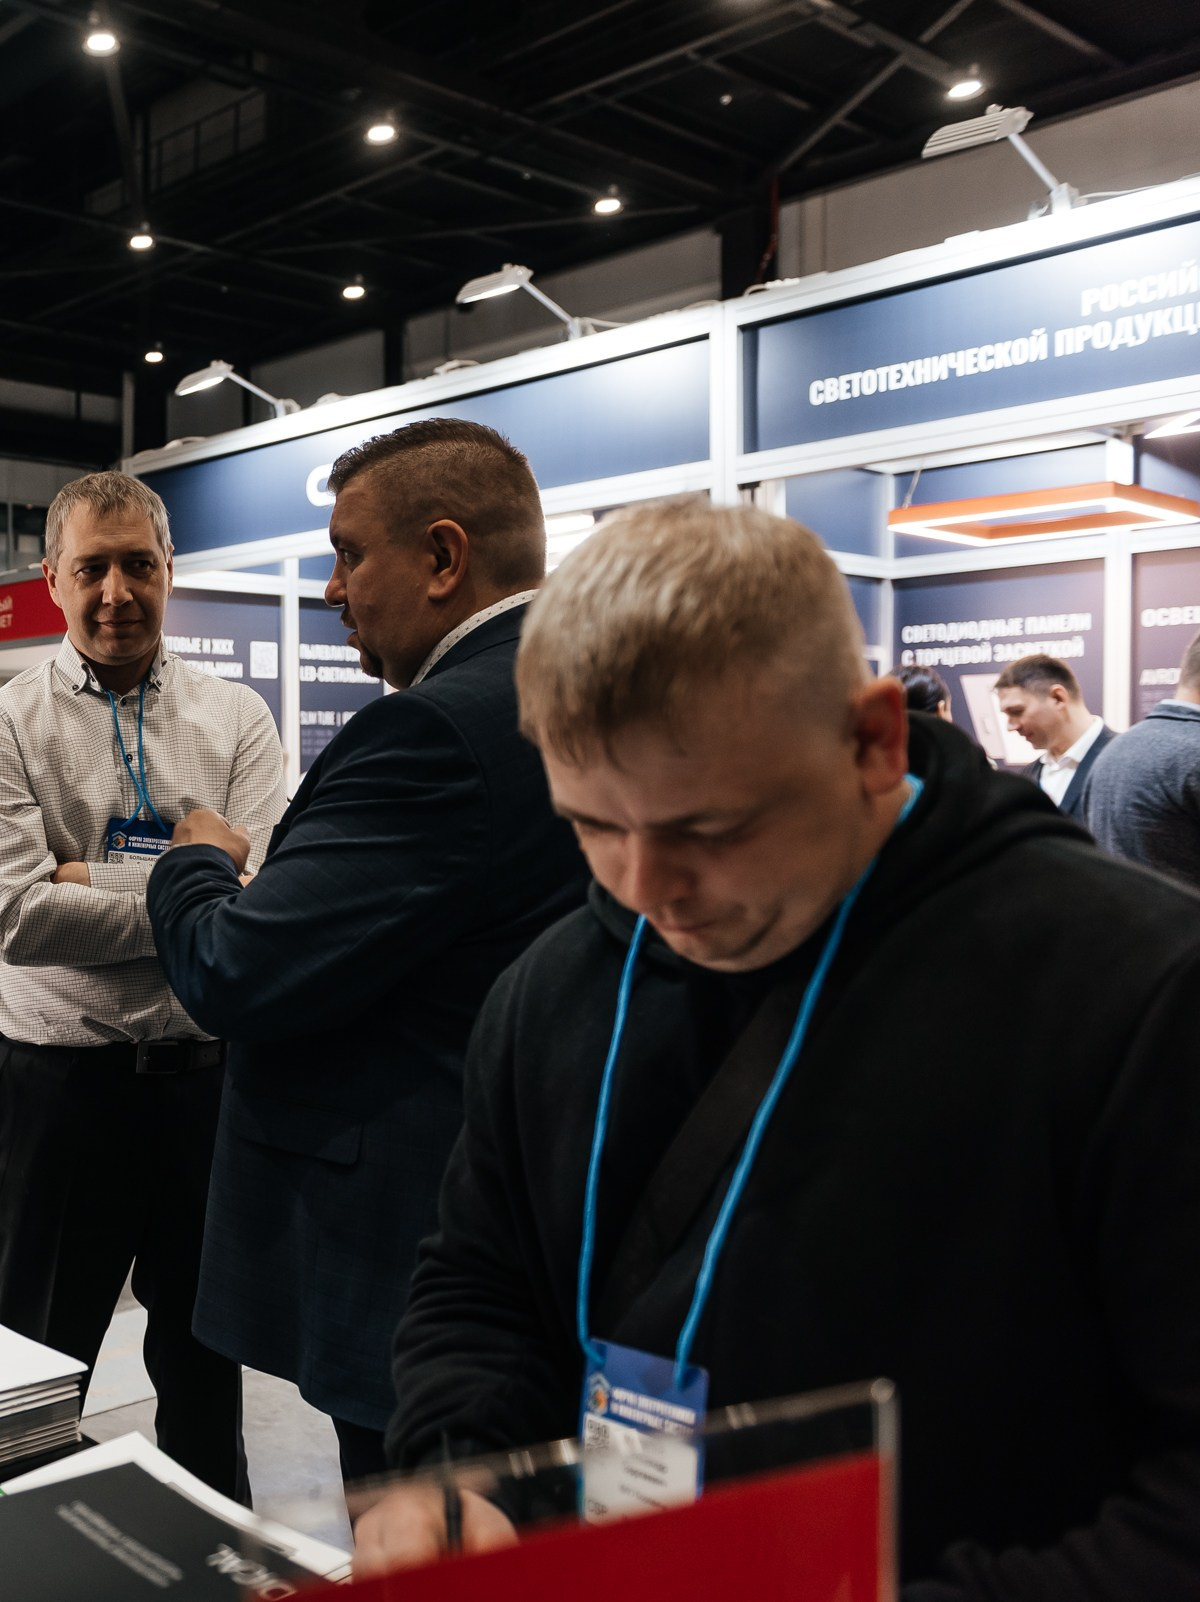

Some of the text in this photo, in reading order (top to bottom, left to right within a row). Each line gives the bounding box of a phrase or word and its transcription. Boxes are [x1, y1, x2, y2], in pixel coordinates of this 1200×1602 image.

[809, 302, 1200, 406] СВЕТОТЕХНИЧЕСКОЙ ПРОДУКЦ
[902, 612, 1092, 644] СВЕТОДИОДНЫЕ ПАНЕЛИ
[916, 641, 992, 667] ТОРЦЕВОЙ
